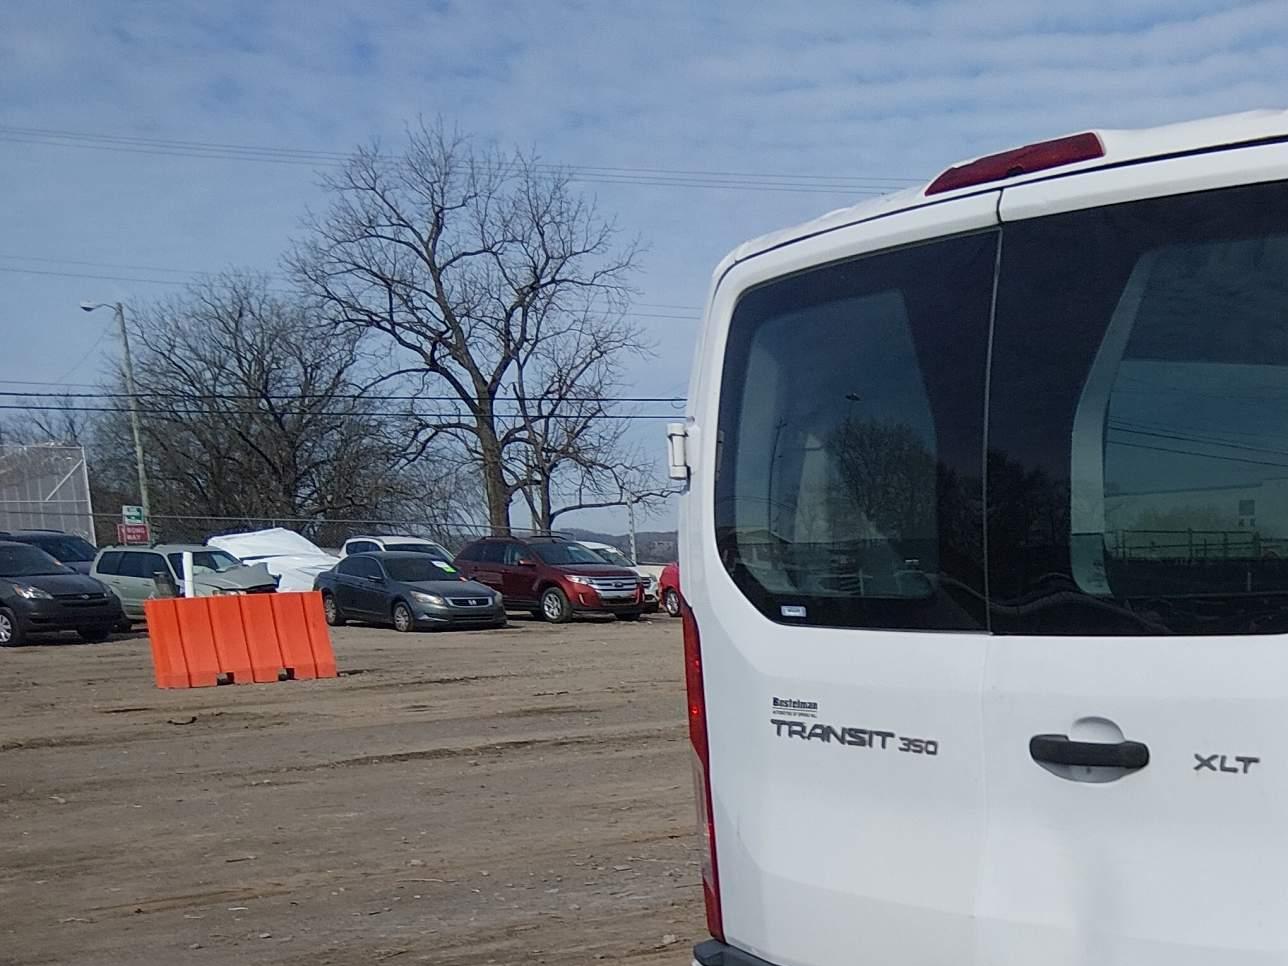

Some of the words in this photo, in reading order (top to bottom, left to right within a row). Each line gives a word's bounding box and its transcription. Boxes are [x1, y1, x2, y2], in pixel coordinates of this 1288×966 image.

[770, 718, 895, 749] TRANSIT
[898, 736, 938, 755] 350
[1193, 753, 1260, 774] XLT
